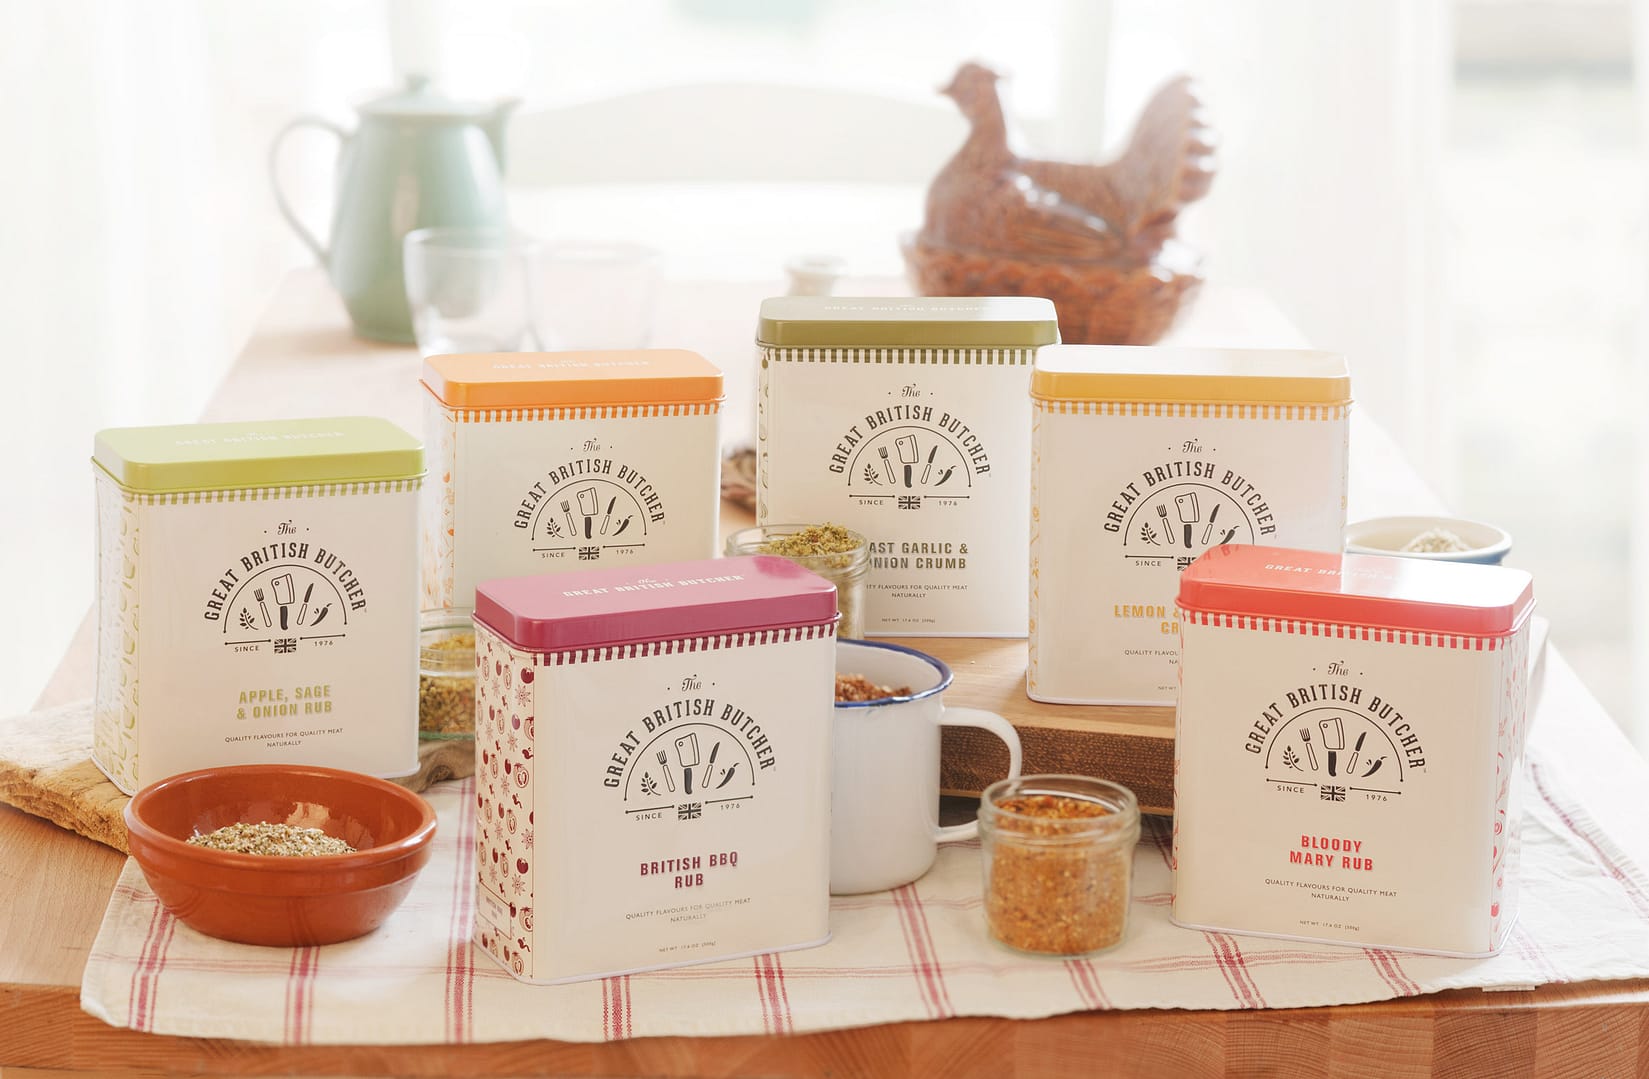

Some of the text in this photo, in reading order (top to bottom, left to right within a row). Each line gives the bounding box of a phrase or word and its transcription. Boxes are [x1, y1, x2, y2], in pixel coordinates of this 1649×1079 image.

[902, 383, 920, 398] The
[583, 438, 600, 452] The
[829, 404, 990, 474] GREAT BRITISH BUTCHER
[1182, 438, 1202, 453] The
[514, 458, 665, 529] GREAT BRITISH BUTCHER
[1104, 461, 1276, 536] GREAT BRITISH BUTCHER
[277, 519, 297, 536] The
[869, 542, 968, 554] AST GARLIC &
[916, 558, 966, 569] CRUMB
[1265, 564, 1313, 573] GREAT
[204, 542, 366, 621] GREAT BRITISH BUTCHER
[614, 581, 674, 593] BRITISH
[678, 575, 744, 587] BUTCHER
[1114, 604, 1165, 618] LEMON
[1328, 660, 1349, 676] The
[682, 674, 702, 692] The
[239, 684, 331, 704] APPLE, SAGE
[236, 701, 333, 720] & ONION RUB
[1245, 684, 1426, 768] GREAT BRITISH BUTCHER
[604, 699, 776, 788] GREAT BRITISH BUTCHER
[1277, 785, 1388, 801] SINCE 1976
[635, 812, 663, 821] SINCE
[1301, 835, 1362, 853] BLOODY
[640, 851, 738, 876] BRITISH BBQ
[1289, 850, 1373, 871] MARY RUB
[675, 873, 704, 889] RUB
[1265, 879, 1294, 887] QUALITY
[1296, 882, 1330, 891] FLAVOURS
[1348, 888, 1377, 896] QUALITY
[1311, 893, 1350, 902] NATURALLY
[626, 911, 654, 920] QUALITY
[656, 906, 688, 916] FLAVOURS
[705, 901, 732, 910] QUALITY
[670, 913, 706, 923] NATURALLY
